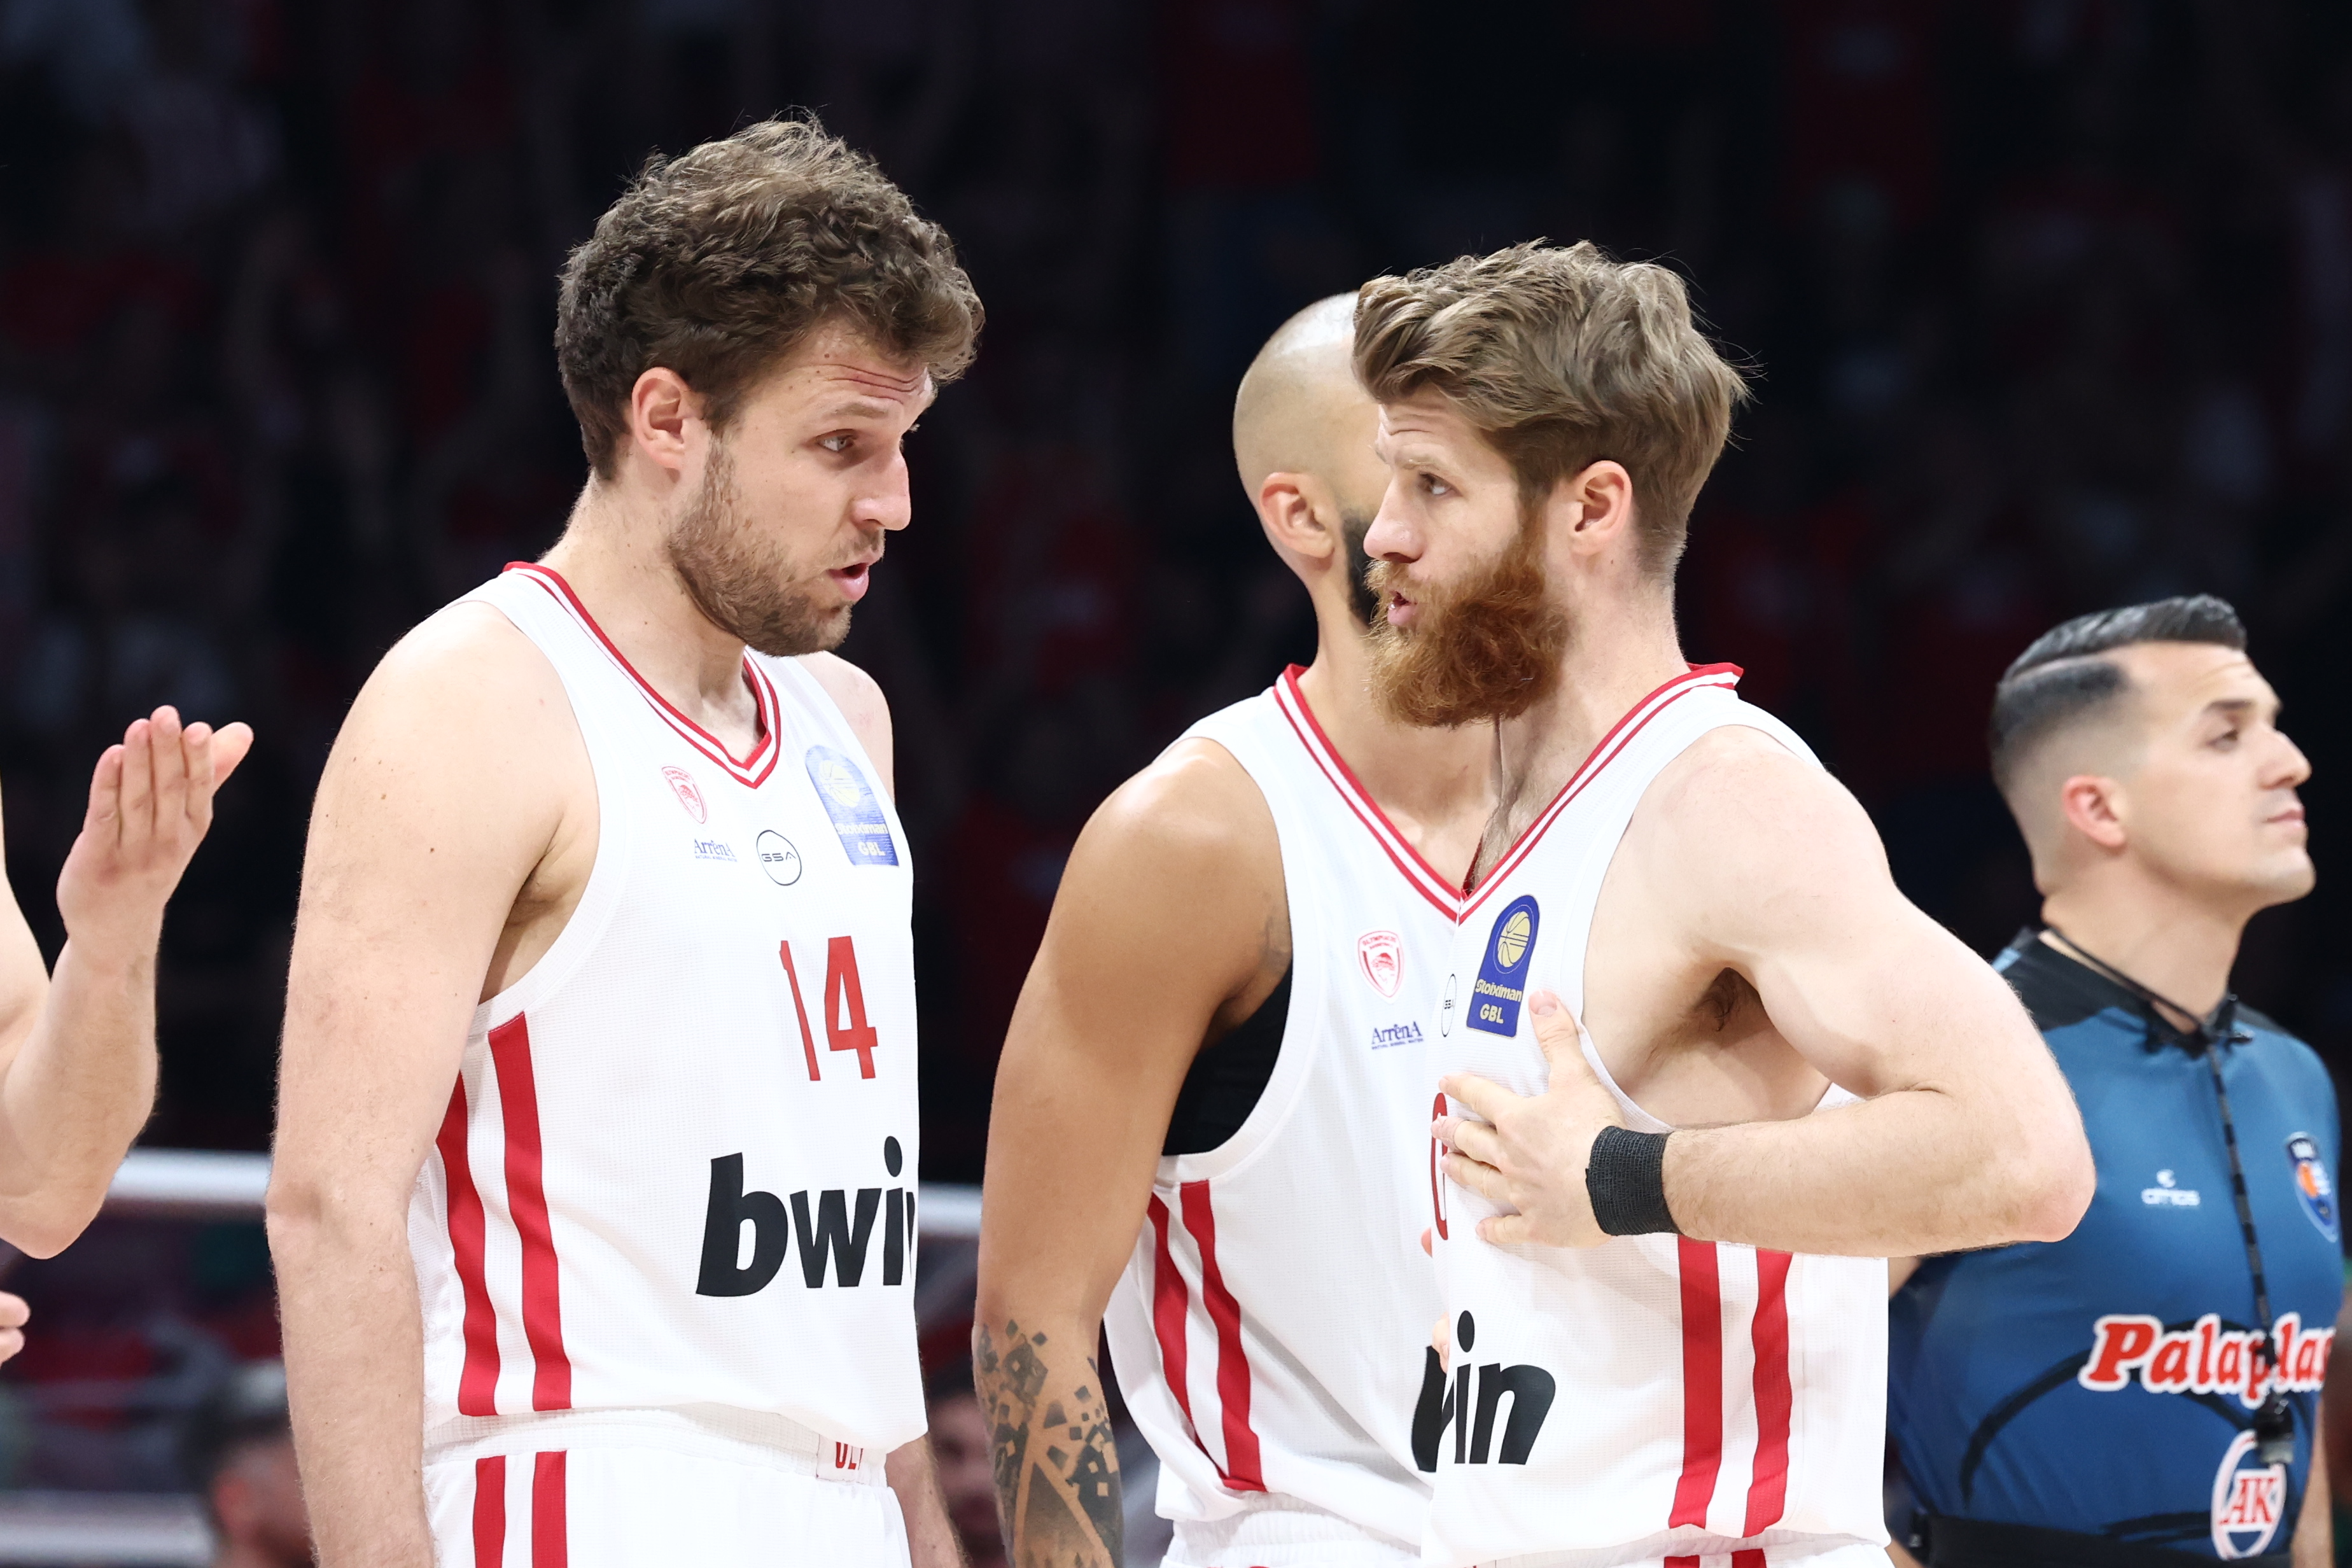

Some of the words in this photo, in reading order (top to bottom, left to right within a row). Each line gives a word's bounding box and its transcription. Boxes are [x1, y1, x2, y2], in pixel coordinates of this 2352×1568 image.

[761, 851, 796, 862] GSA
[857, 841, 886, 856] GBL
[1475, 978, 1523, 1002] Stoiximan
[779, 935, 878, 1081] 14
[1480, 1004, 1504, 1024] GBL
[696, 1136, 915, 1297] bwi
[2219, 1476, 2279, 1524] AK
